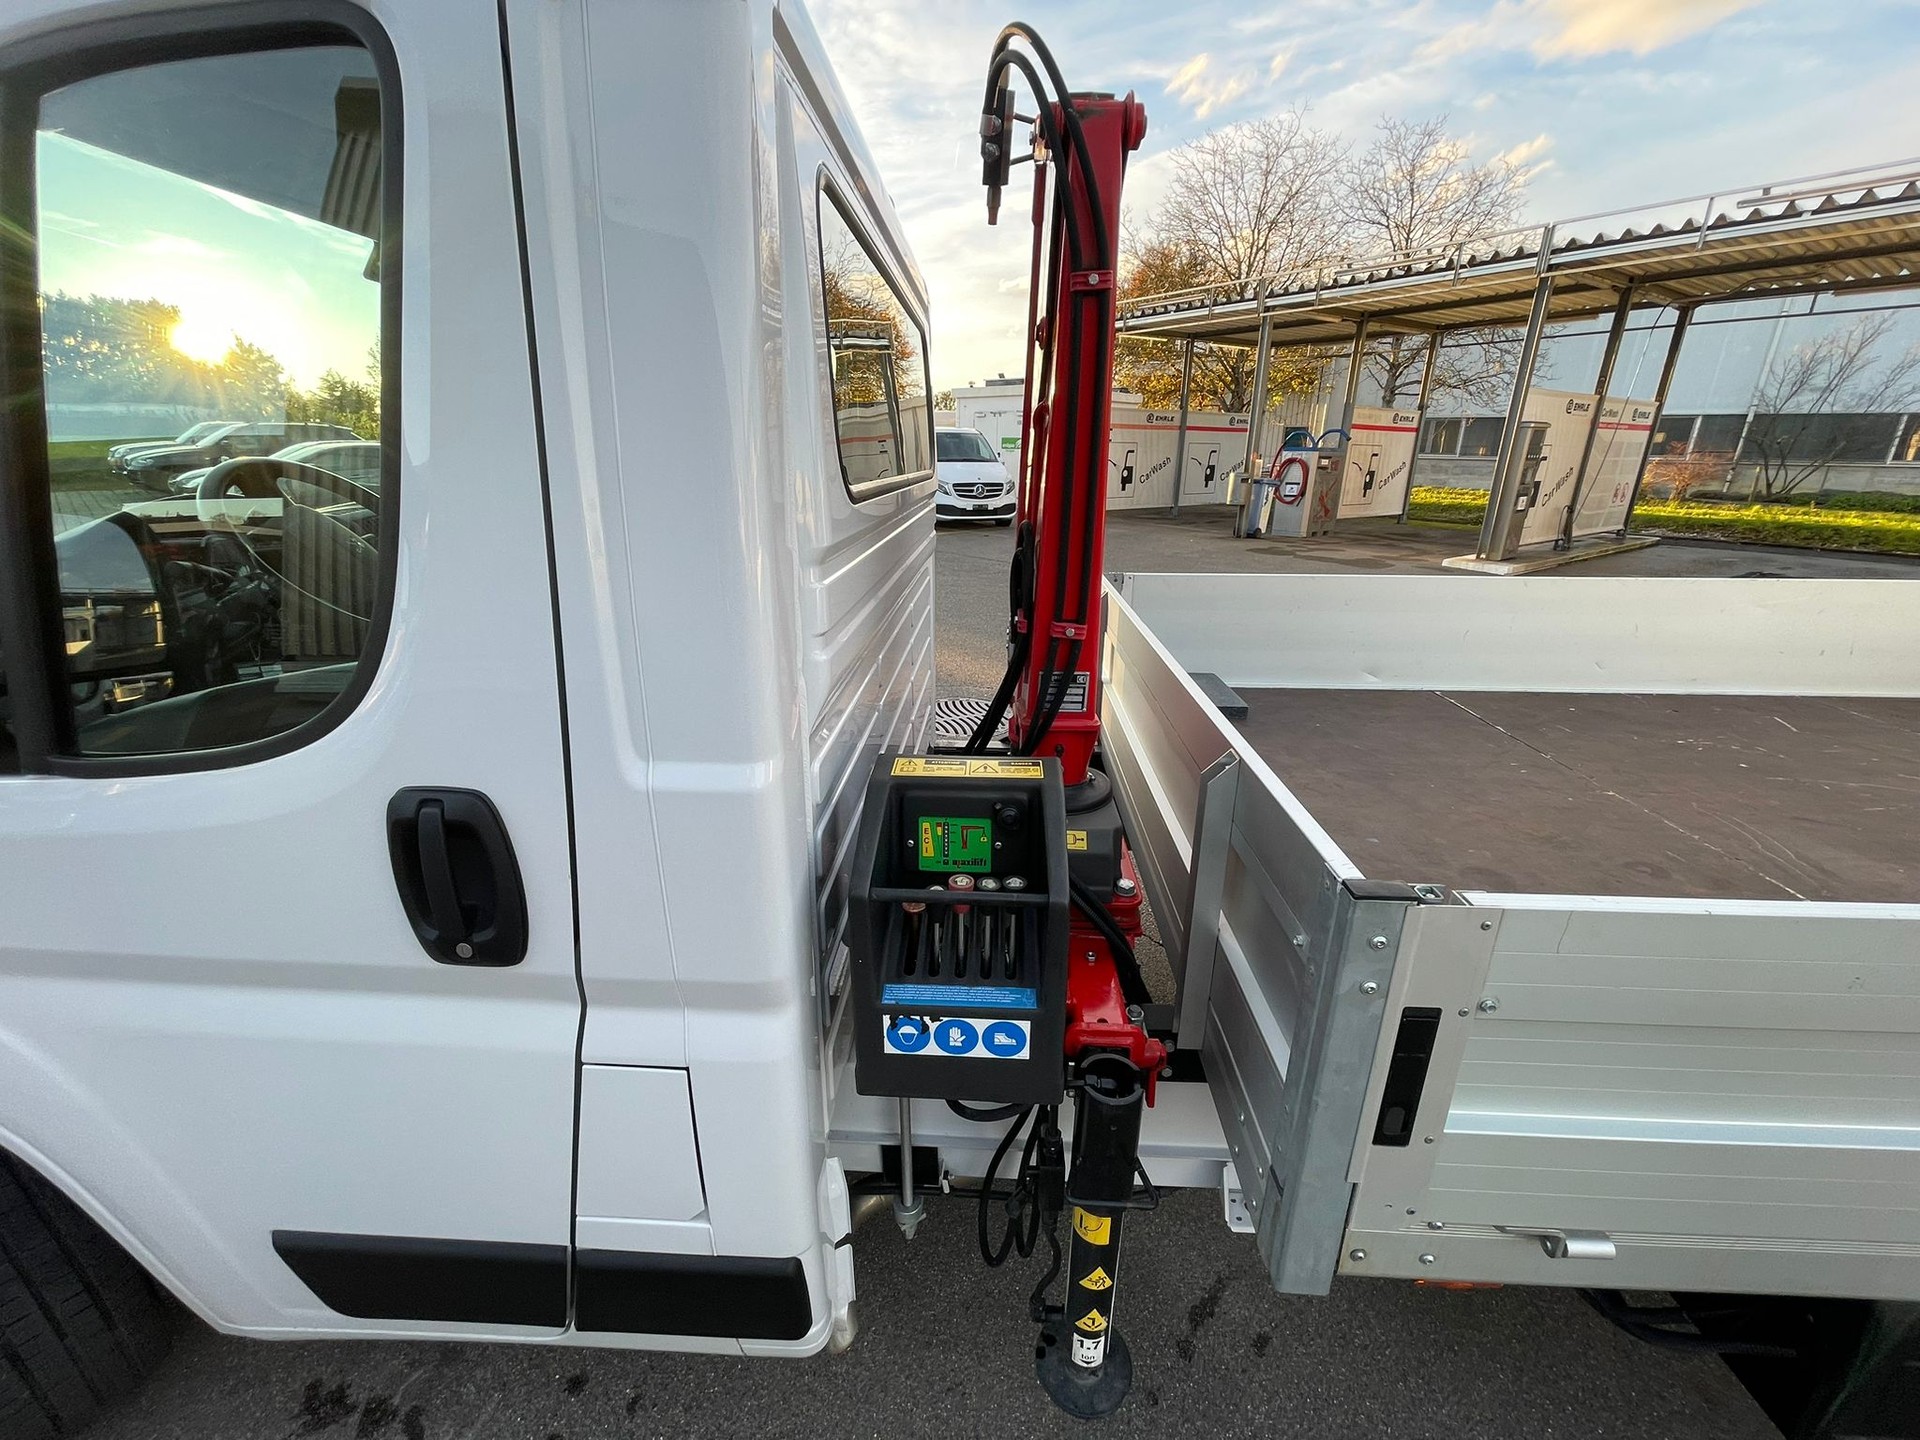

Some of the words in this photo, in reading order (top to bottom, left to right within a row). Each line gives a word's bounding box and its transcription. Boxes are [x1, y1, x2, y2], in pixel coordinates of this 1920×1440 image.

[1573, 402, 1591, 412] EHRLE
[1637, 410, 1652, 419] EHRLE
[1399, 415, 1415, 423] EHRLE
[1139, 456, 1172, 484] CarWash
[1220, 459, 1245, 481] CarWas
[1378, 461, 1407, 490] CarWash
[1541, 466, 1574, 507] CarWash
[1076, 1339, 1102, 1350] 1.7
